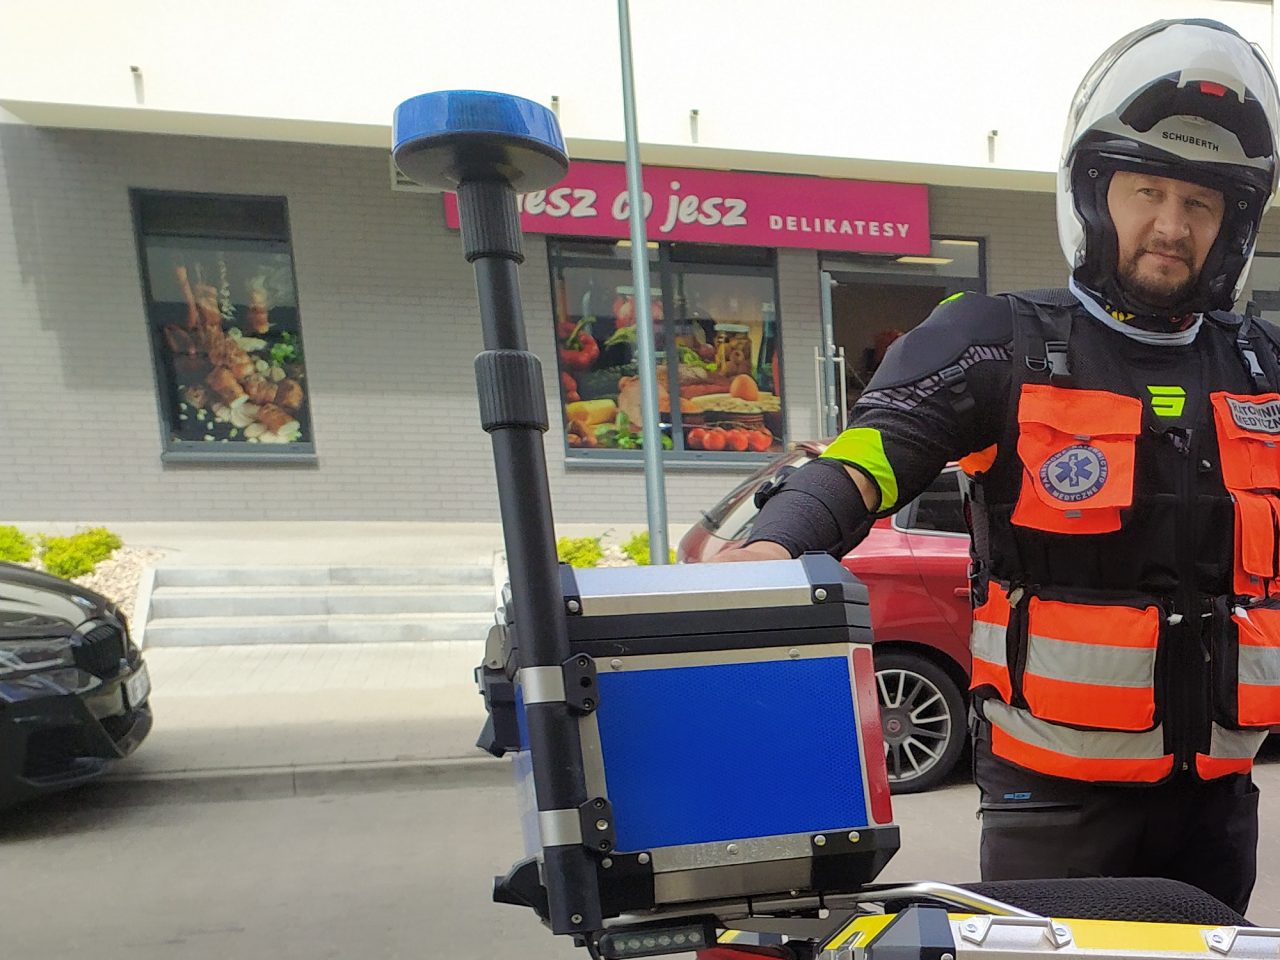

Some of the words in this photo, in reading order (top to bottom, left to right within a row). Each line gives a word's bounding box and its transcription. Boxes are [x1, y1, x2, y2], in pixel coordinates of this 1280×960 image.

[1162, 131, 1220, 152] SCHUBERTH
[659, 181, 748, 233] jesz
[769, 214, 910, 238] DELIKATESY
